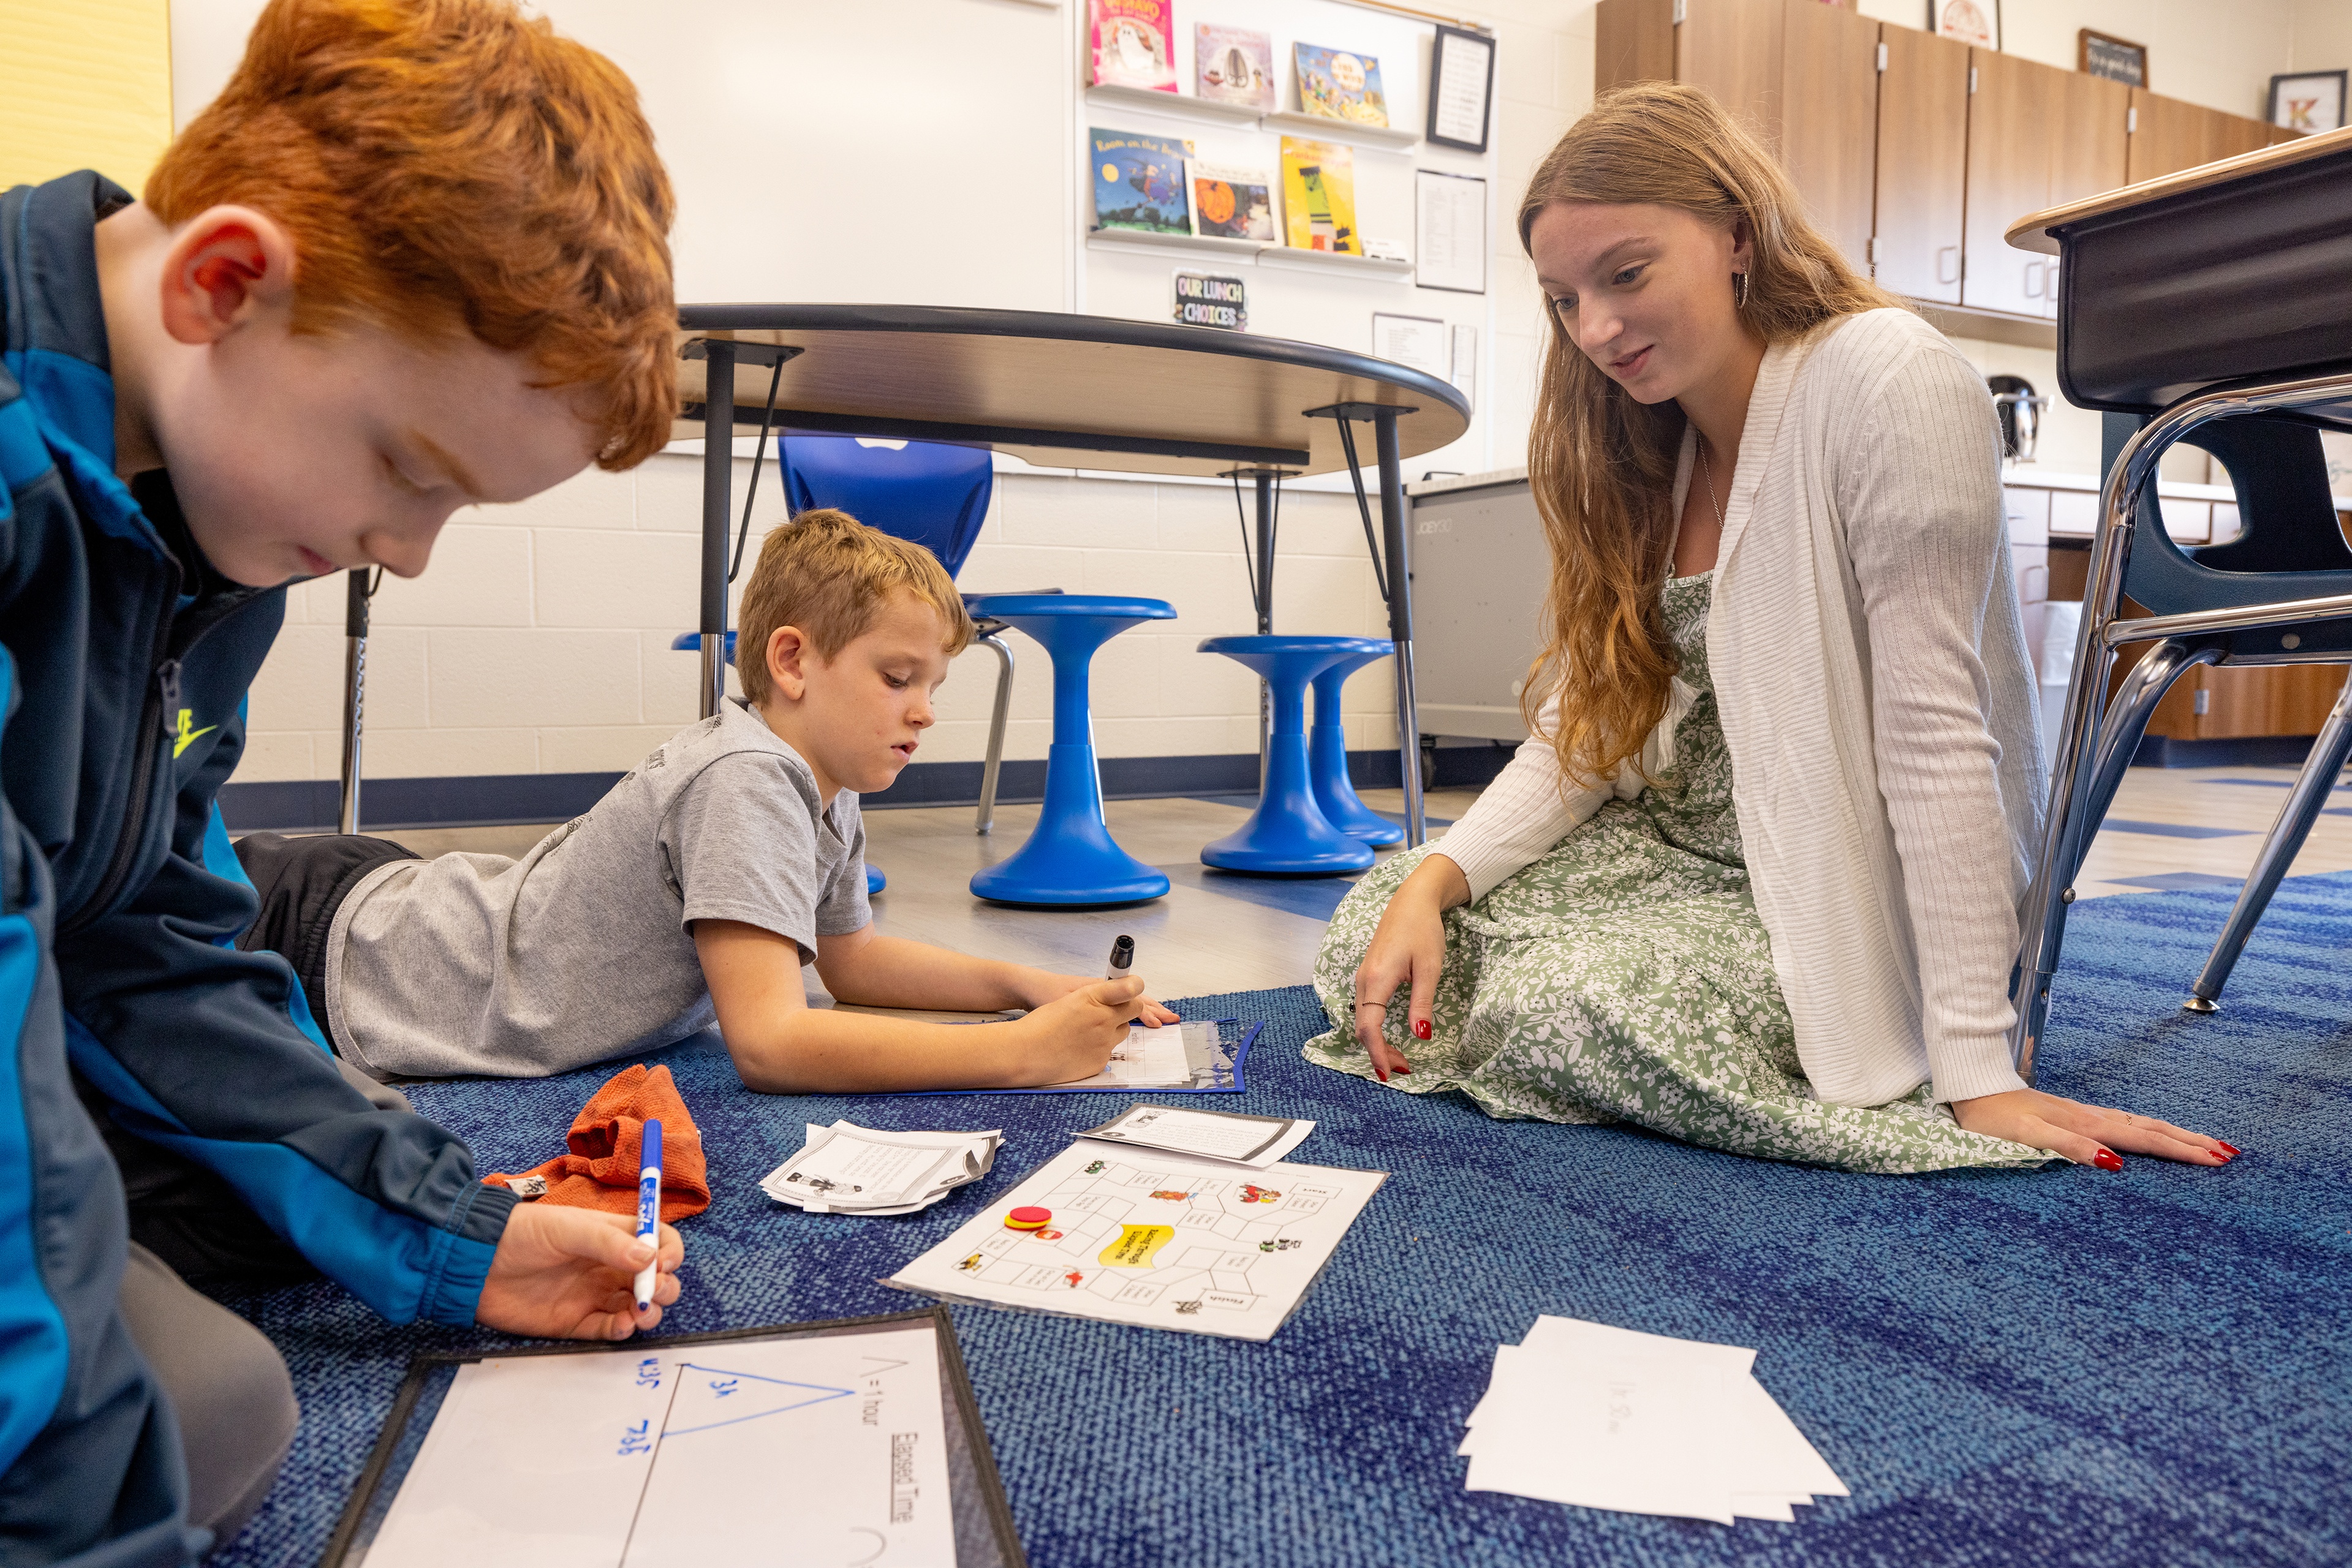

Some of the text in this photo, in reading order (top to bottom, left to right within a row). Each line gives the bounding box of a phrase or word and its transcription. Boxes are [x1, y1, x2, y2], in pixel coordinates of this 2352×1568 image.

[2288, 99, 2318, 129] K
[1096, 140, 1125, 152] Room
[1141, 139, 1158, 151] the
[1178, 277, 1243, 303] OUR LUNCH
[1184, 303, 1236, 326] CHOICES
[1115, 1231, 1142, 1260] Elapsed Time
[1128, 1229, 1159, 1264] Racing Through
[1209, 1295, 1244, 1305] Finish
[636, 1358, 661, 1389] 4:35
[863, 1399, 883, 1426] hour
[894, 1432, 919, 1523] Elapsed Time
